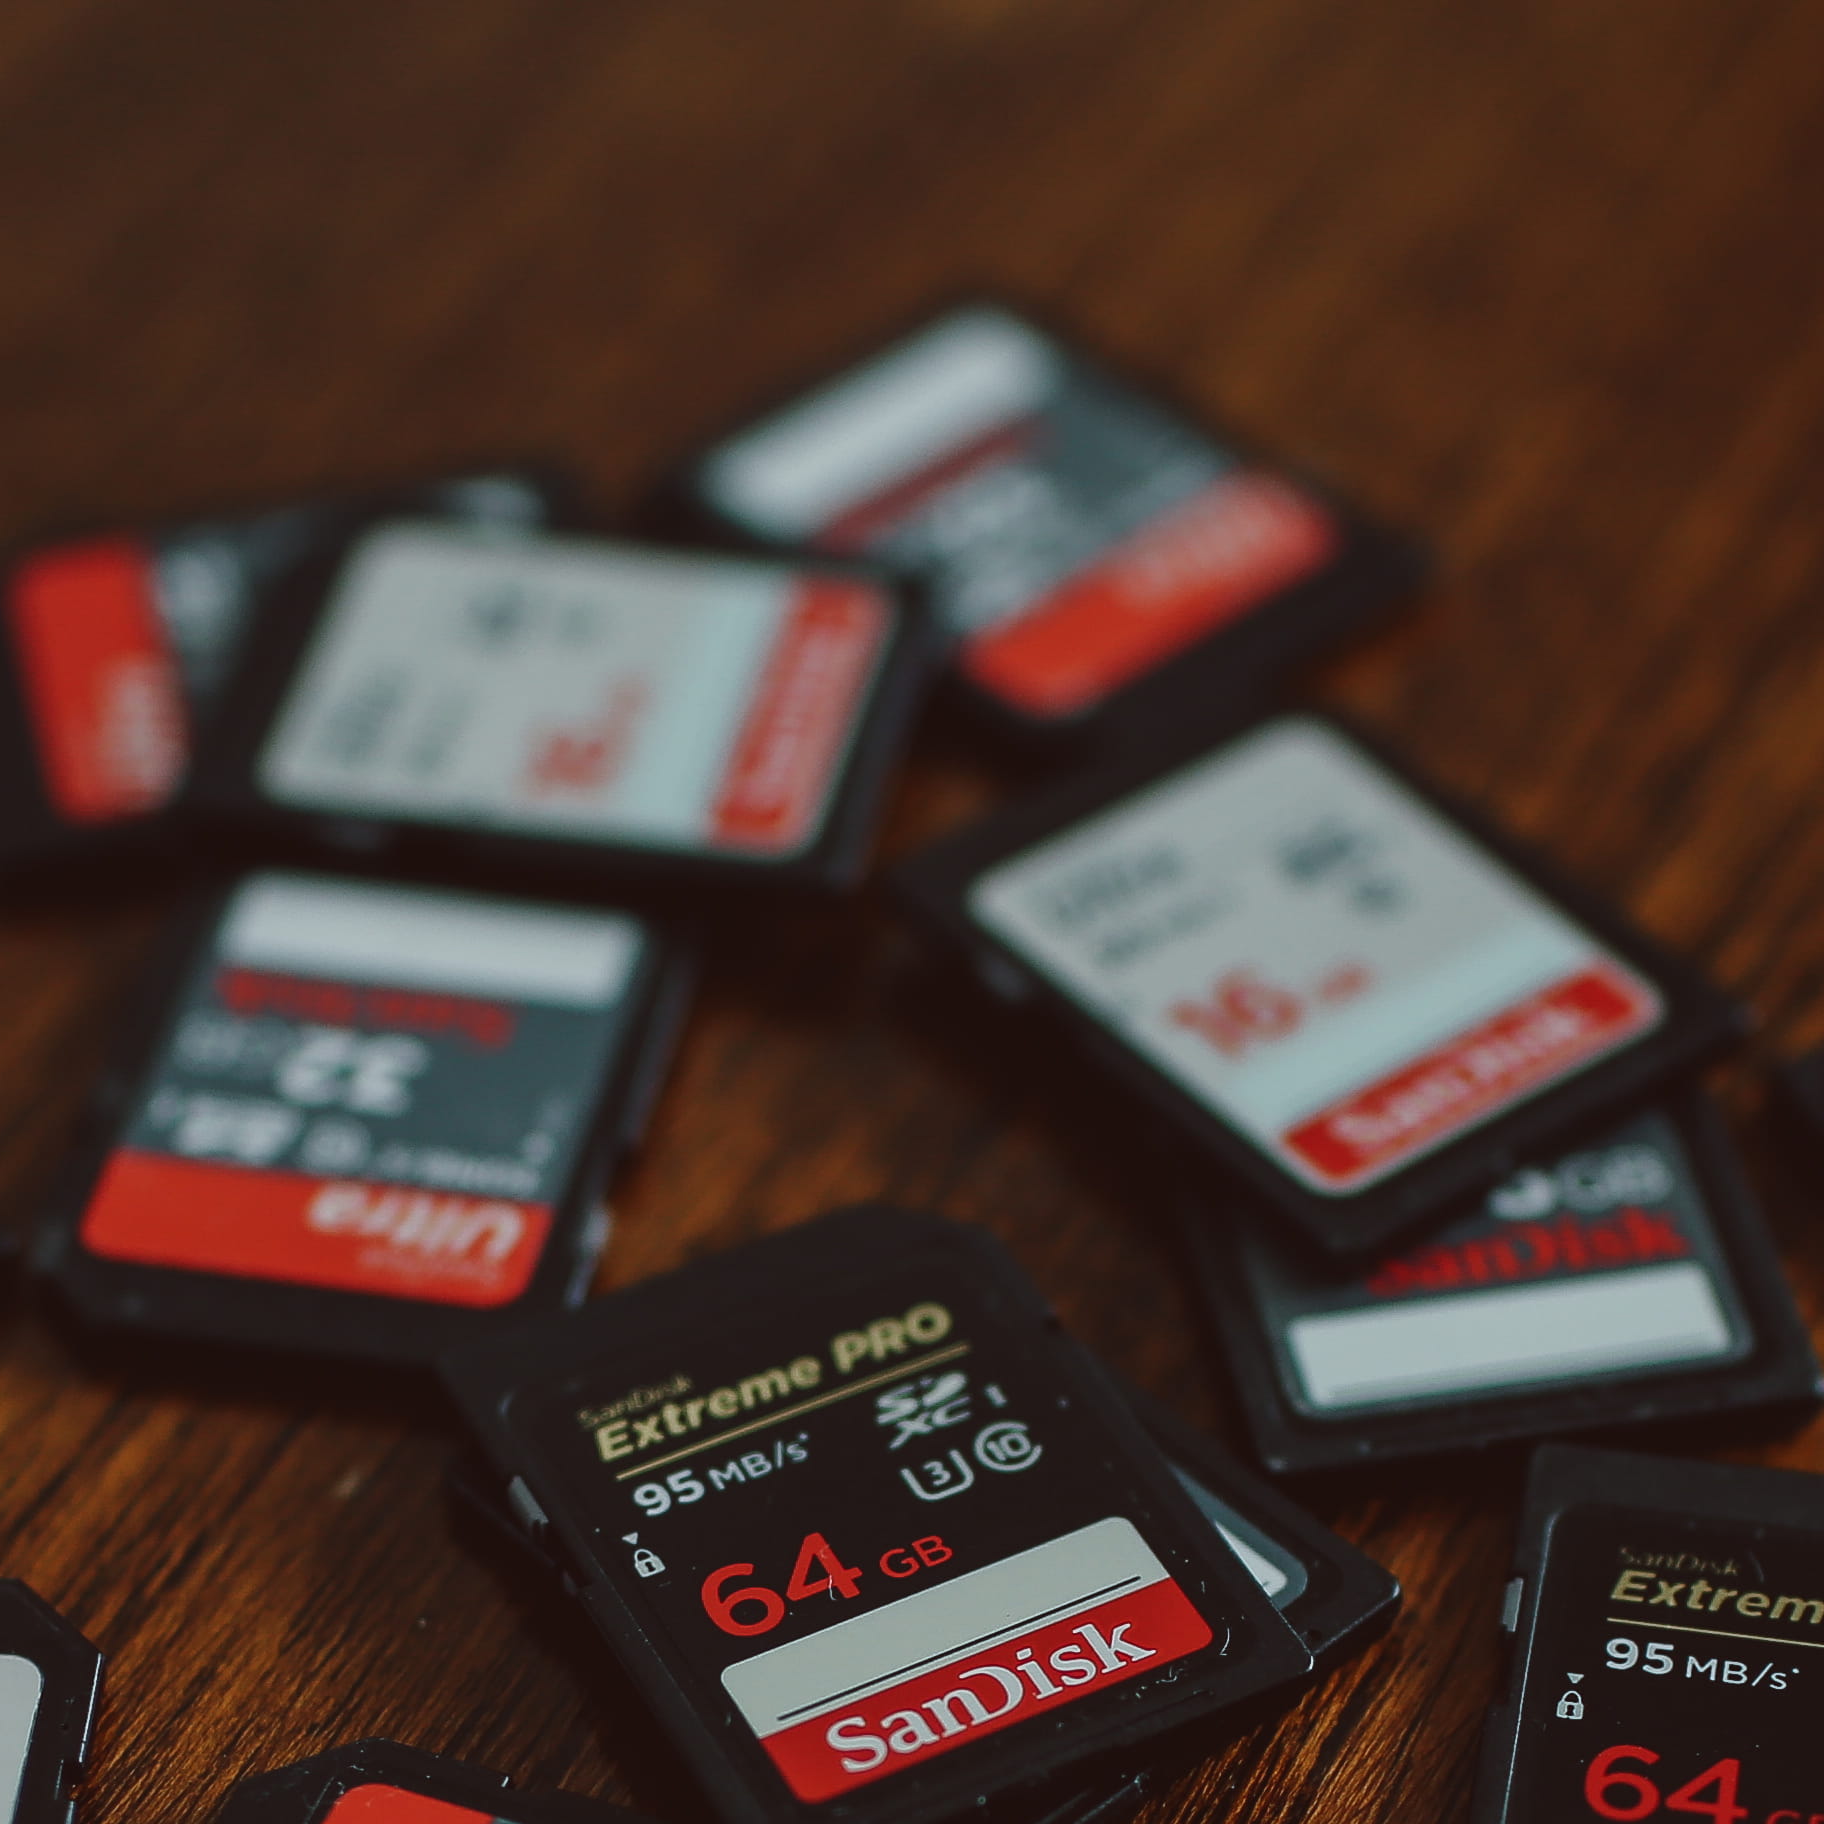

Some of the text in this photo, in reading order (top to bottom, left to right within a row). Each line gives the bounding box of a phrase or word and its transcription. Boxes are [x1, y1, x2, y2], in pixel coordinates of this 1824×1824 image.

[279, 1026, 429, 1117] 32
[306, 1179, 524, 1261] Ultra
[595, 1303, 953, 1463] Extreme PRO
[633, 1470, 706, 1516] 95
[699, 1531, 954, 1638] 64 GB
[826, 1620, 1158, 1774] SanDisk
[1605, 1637, 1675, 1676] 95
